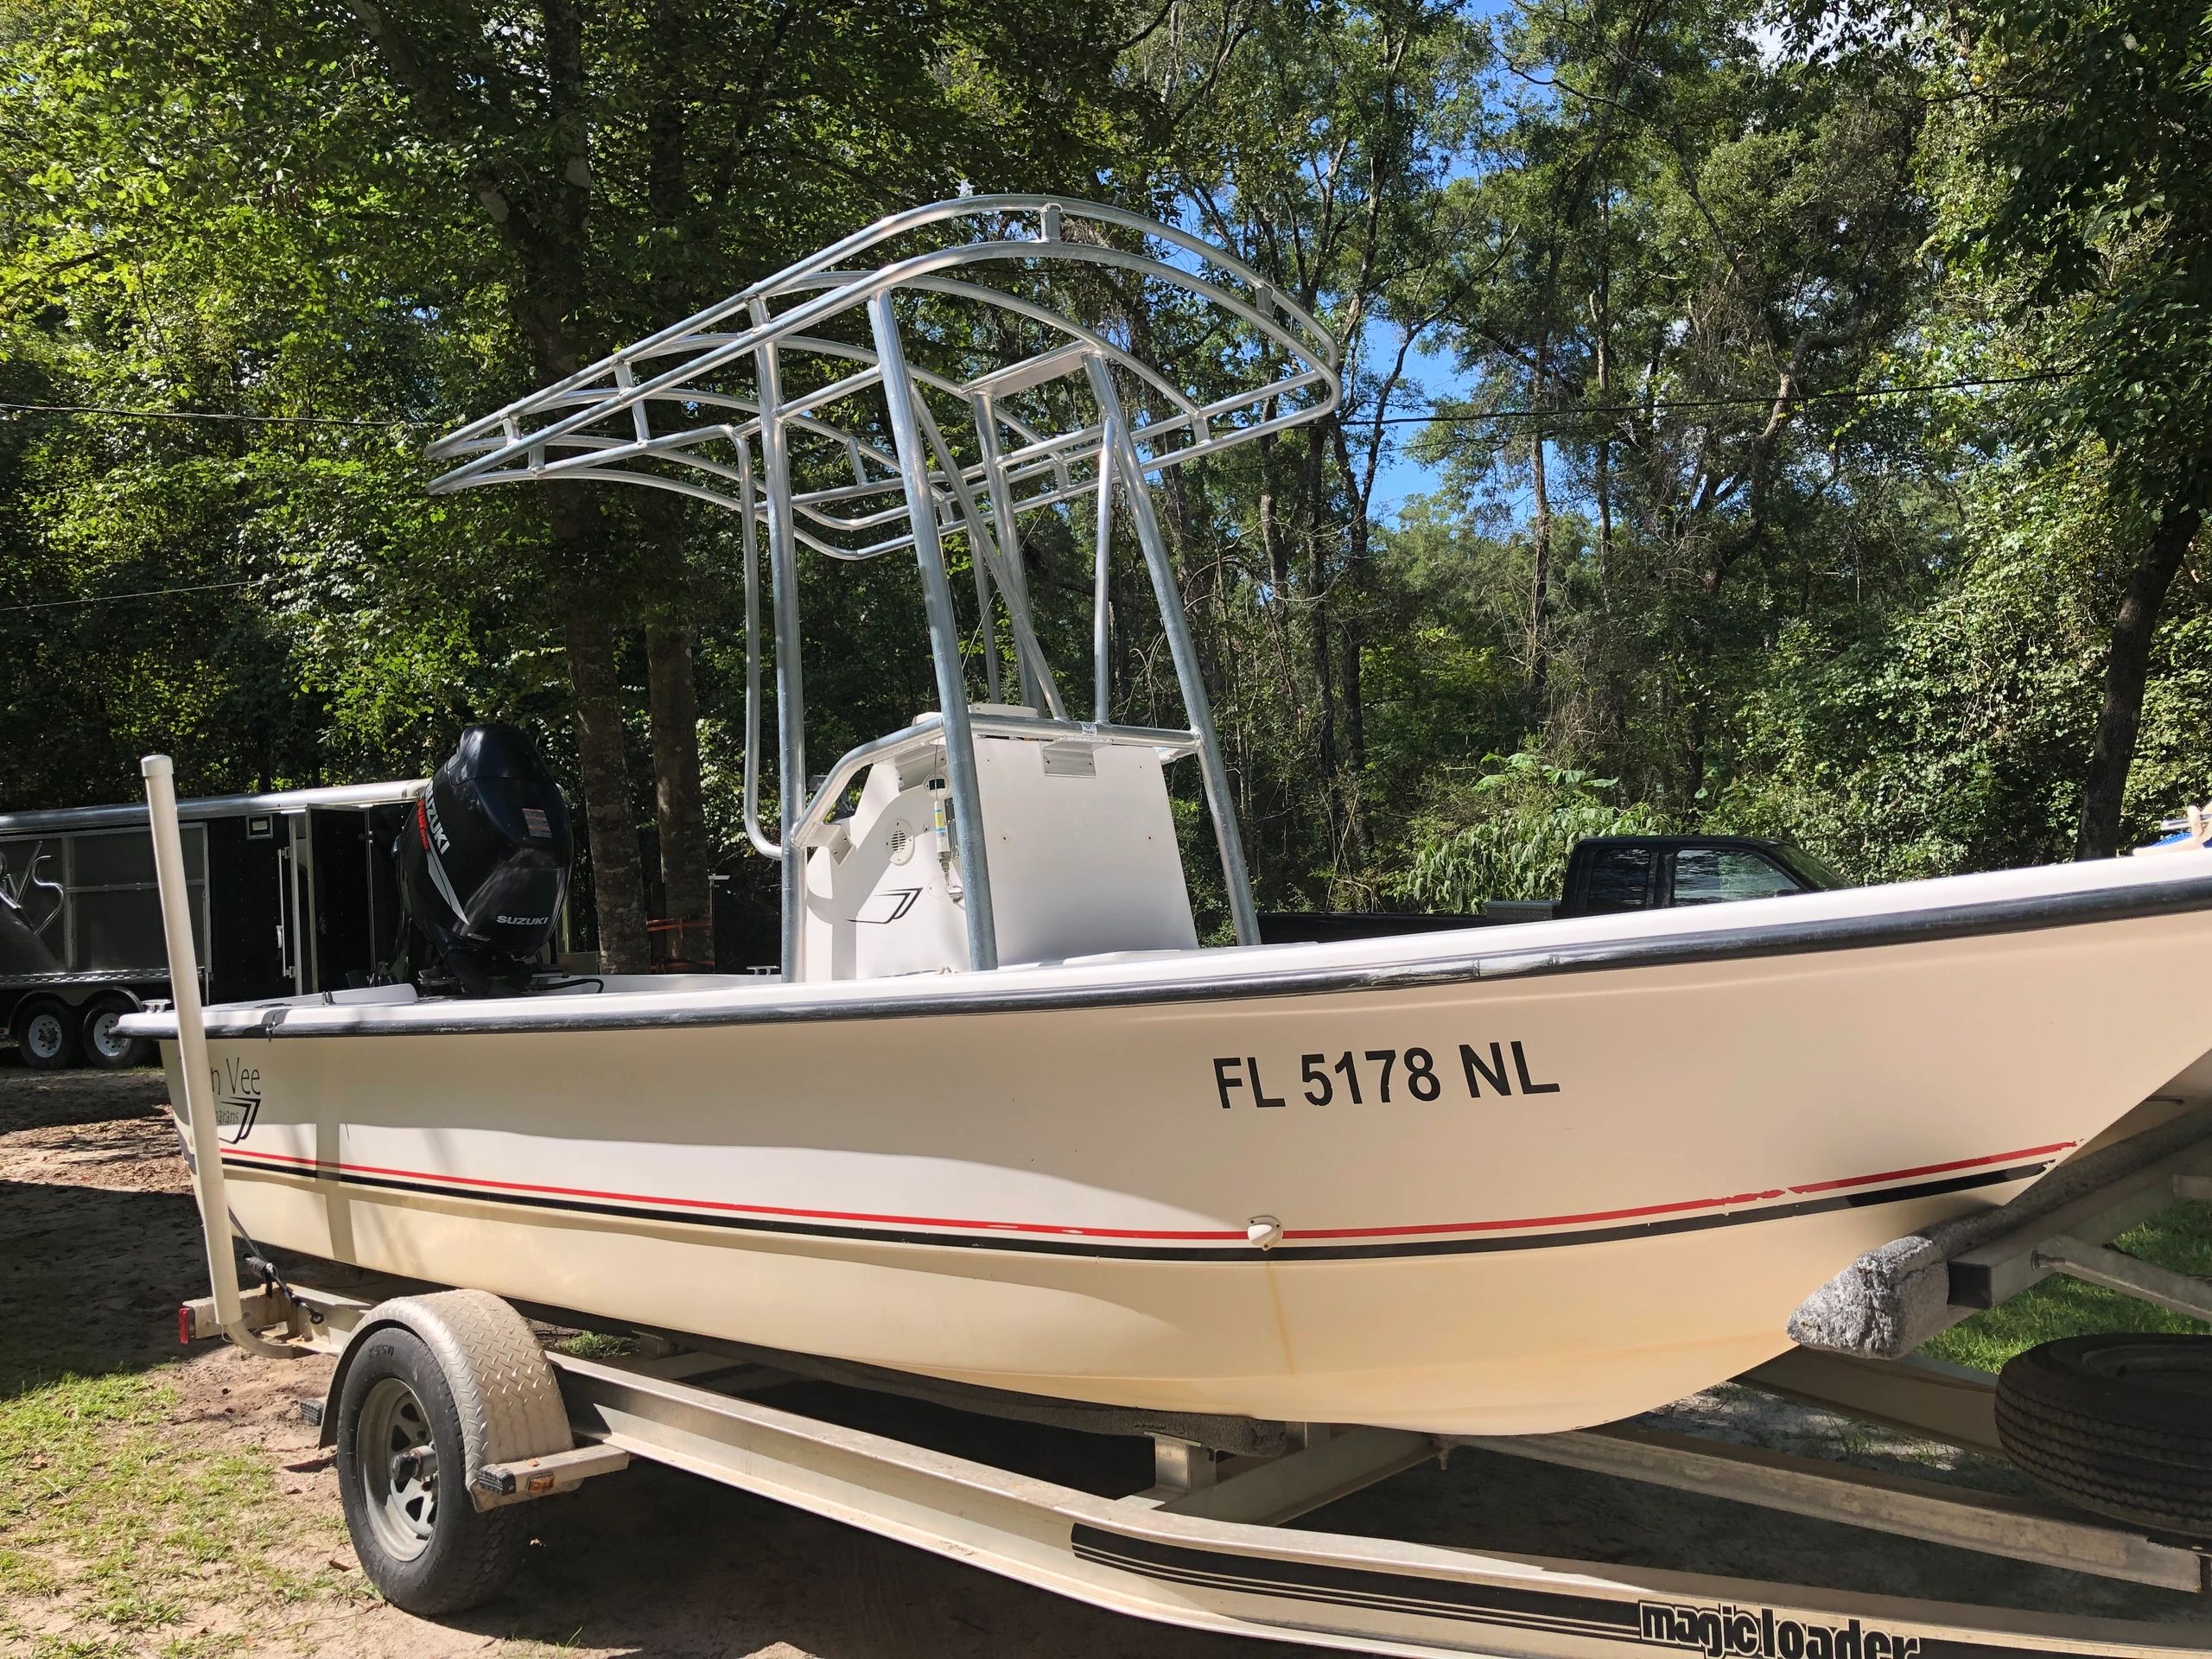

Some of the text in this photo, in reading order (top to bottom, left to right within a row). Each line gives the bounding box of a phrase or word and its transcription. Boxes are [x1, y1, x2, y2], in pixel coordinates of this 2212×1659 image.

[496, 915, 549, 925] SUZUKI
[226, 1057, 261, 1095] Vee
[1213, 1040, 1560, 1109] FL 5178 NL
